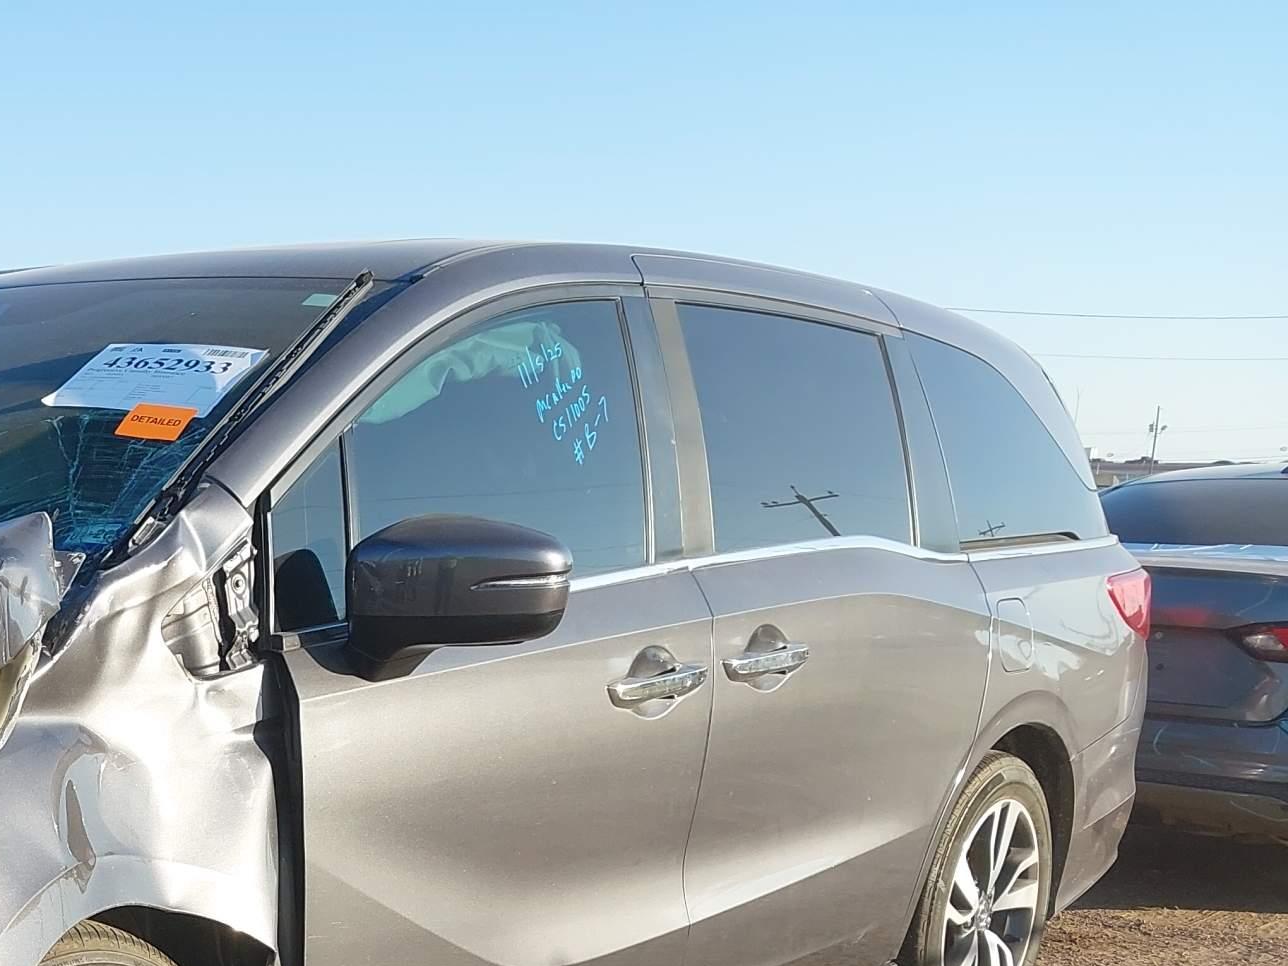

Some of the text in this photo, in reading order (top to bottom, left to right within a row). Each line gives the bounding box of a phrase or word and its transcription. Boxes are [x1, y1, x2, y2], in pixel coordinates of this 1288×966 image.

[103, 355, 233, 375] 43652933
[517, 342, 562, 388] 11/5/25
[130, 414, 183, 428] DETAILED
